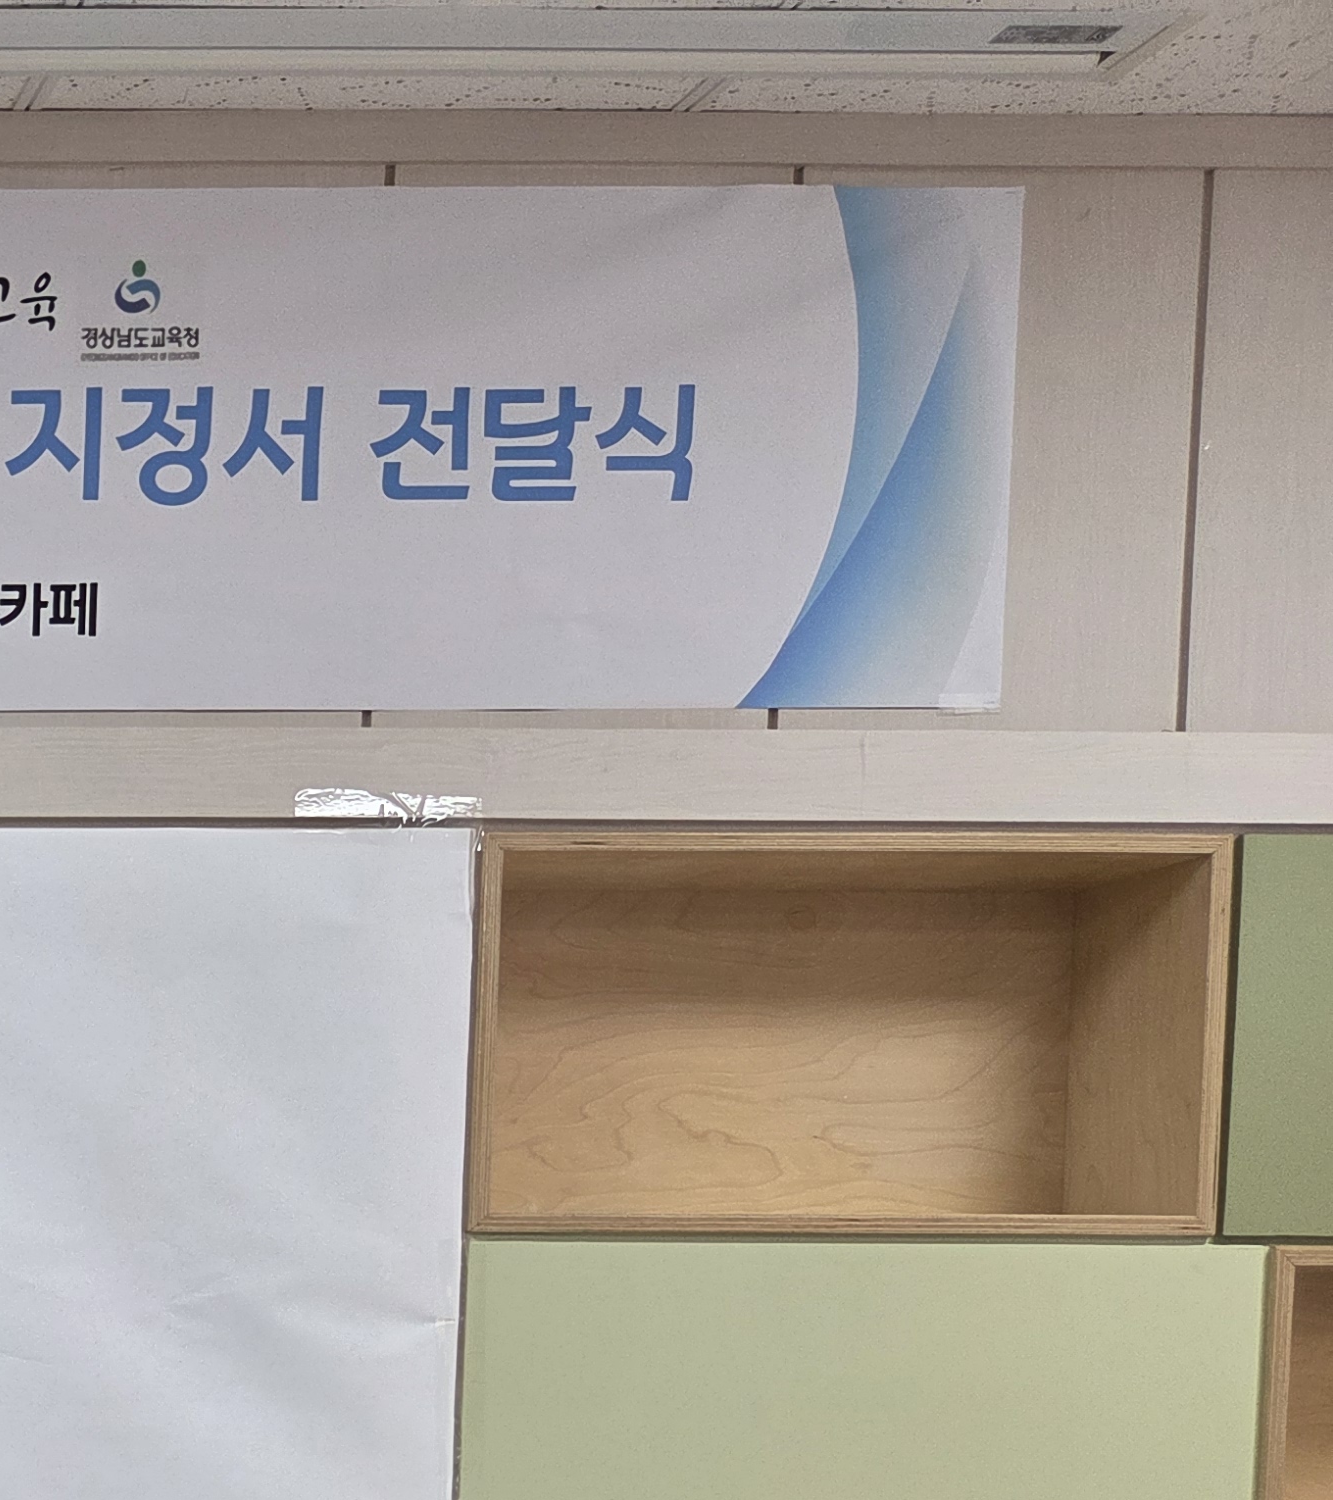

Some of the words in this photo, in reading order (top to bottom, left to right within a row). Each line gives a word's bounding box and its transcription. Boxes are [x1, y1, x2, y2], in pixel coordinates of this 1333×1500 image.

[80, 326, 200, 349] 경상남도교육청
[5, 385, 324, 506] 지정서
[369, 384, 696, 502] 전달식
